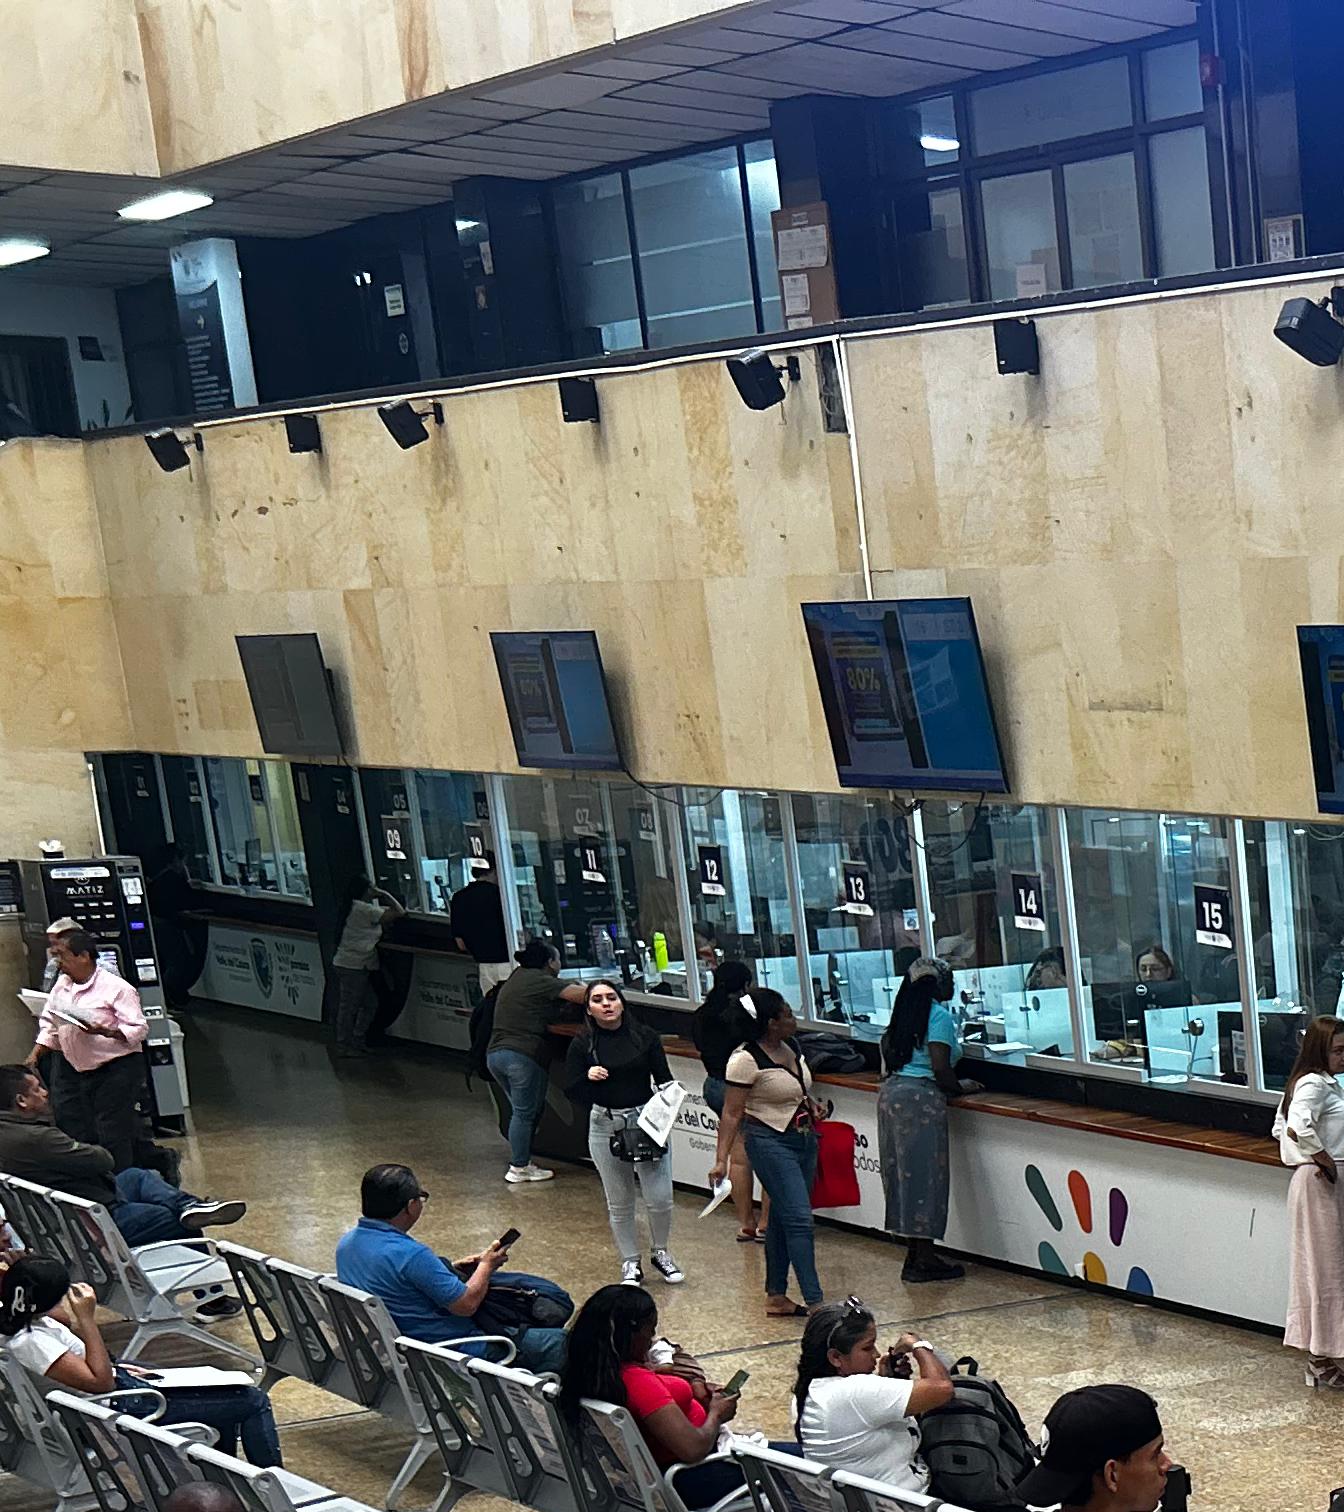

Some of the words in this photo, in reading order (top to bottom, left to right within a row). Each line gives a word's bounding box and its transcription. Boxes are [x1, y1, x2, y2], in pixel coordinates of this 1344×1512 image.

[846, 667, 881, 691] 80%
[386, 829, 402, 849] 09
[470, 836, 483, 856] 10
[585, 849, 597, 870] 11
[705, 859, 719, 881] 12
[66, 885, 104, 895] MATIZ
[850, 876, 866, 901] 13
[1018, 888, 1038, 915] 14
[1202, 901, 1223, 930] 15
[853, 1153, 882, 1174] odos
